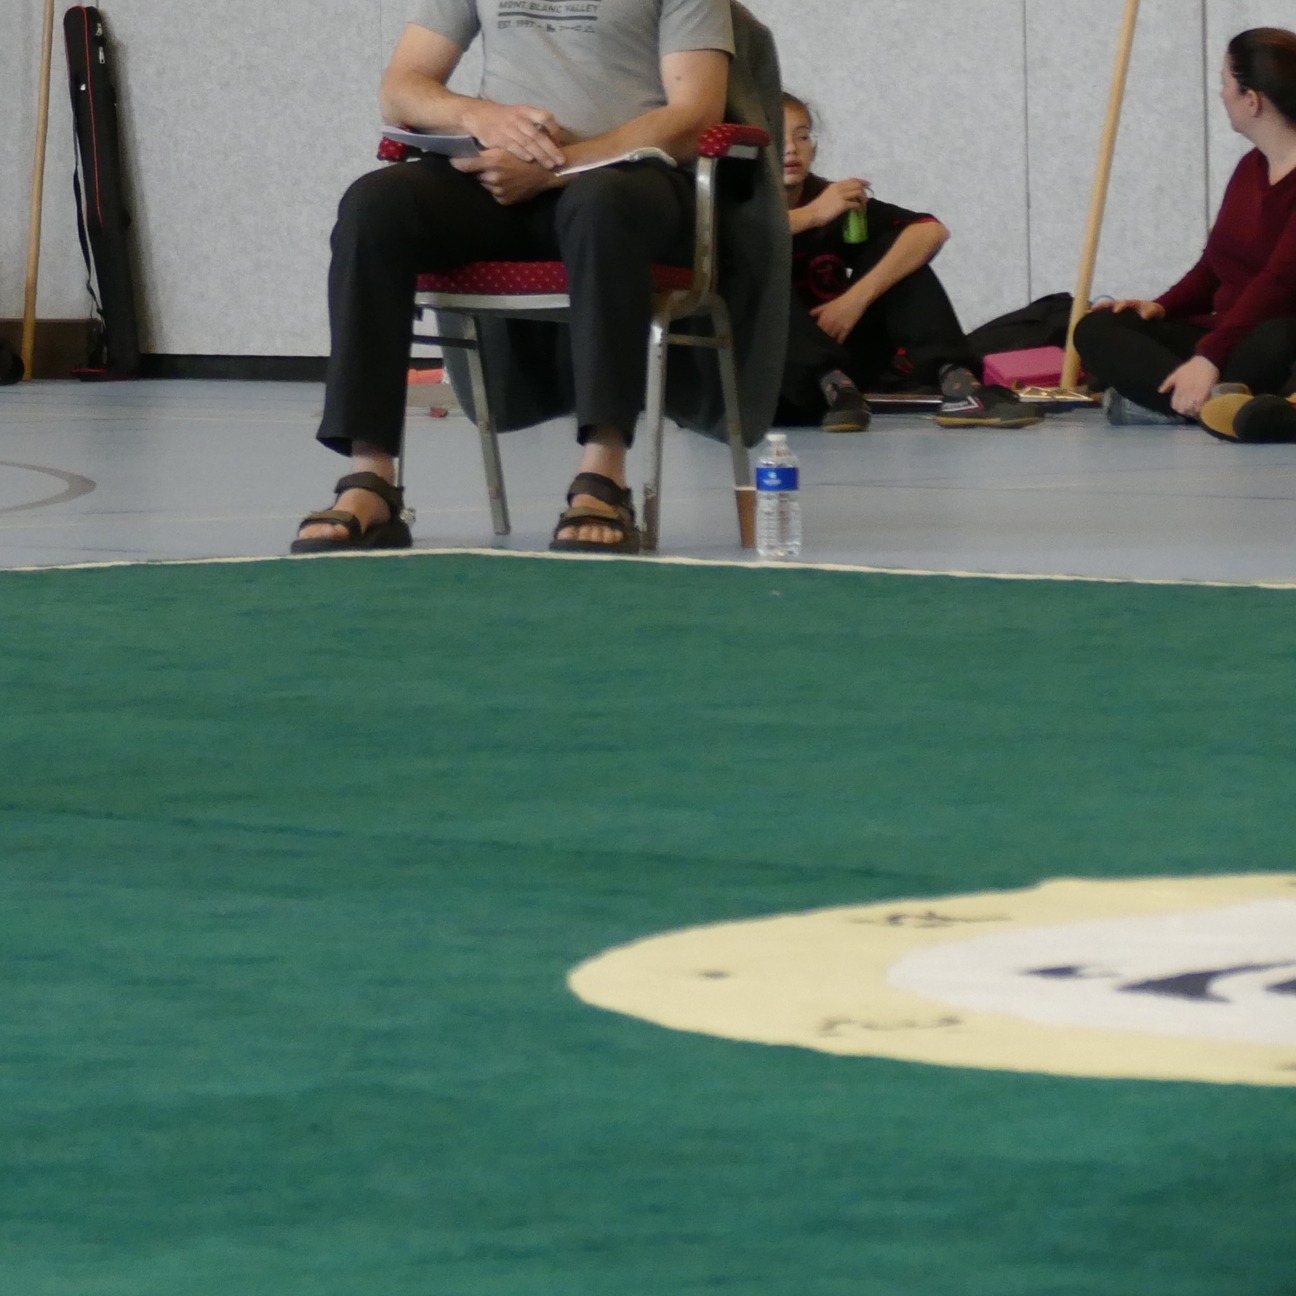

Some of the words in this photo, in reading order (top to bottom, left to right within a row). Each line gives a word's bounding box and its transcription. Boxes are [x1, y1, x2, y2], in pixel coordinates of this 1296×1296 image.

[499, 1, 526, 9] MONT
[529, 3, 562, 13] BLANC
[565, 3, 598, 13] VALLEY
